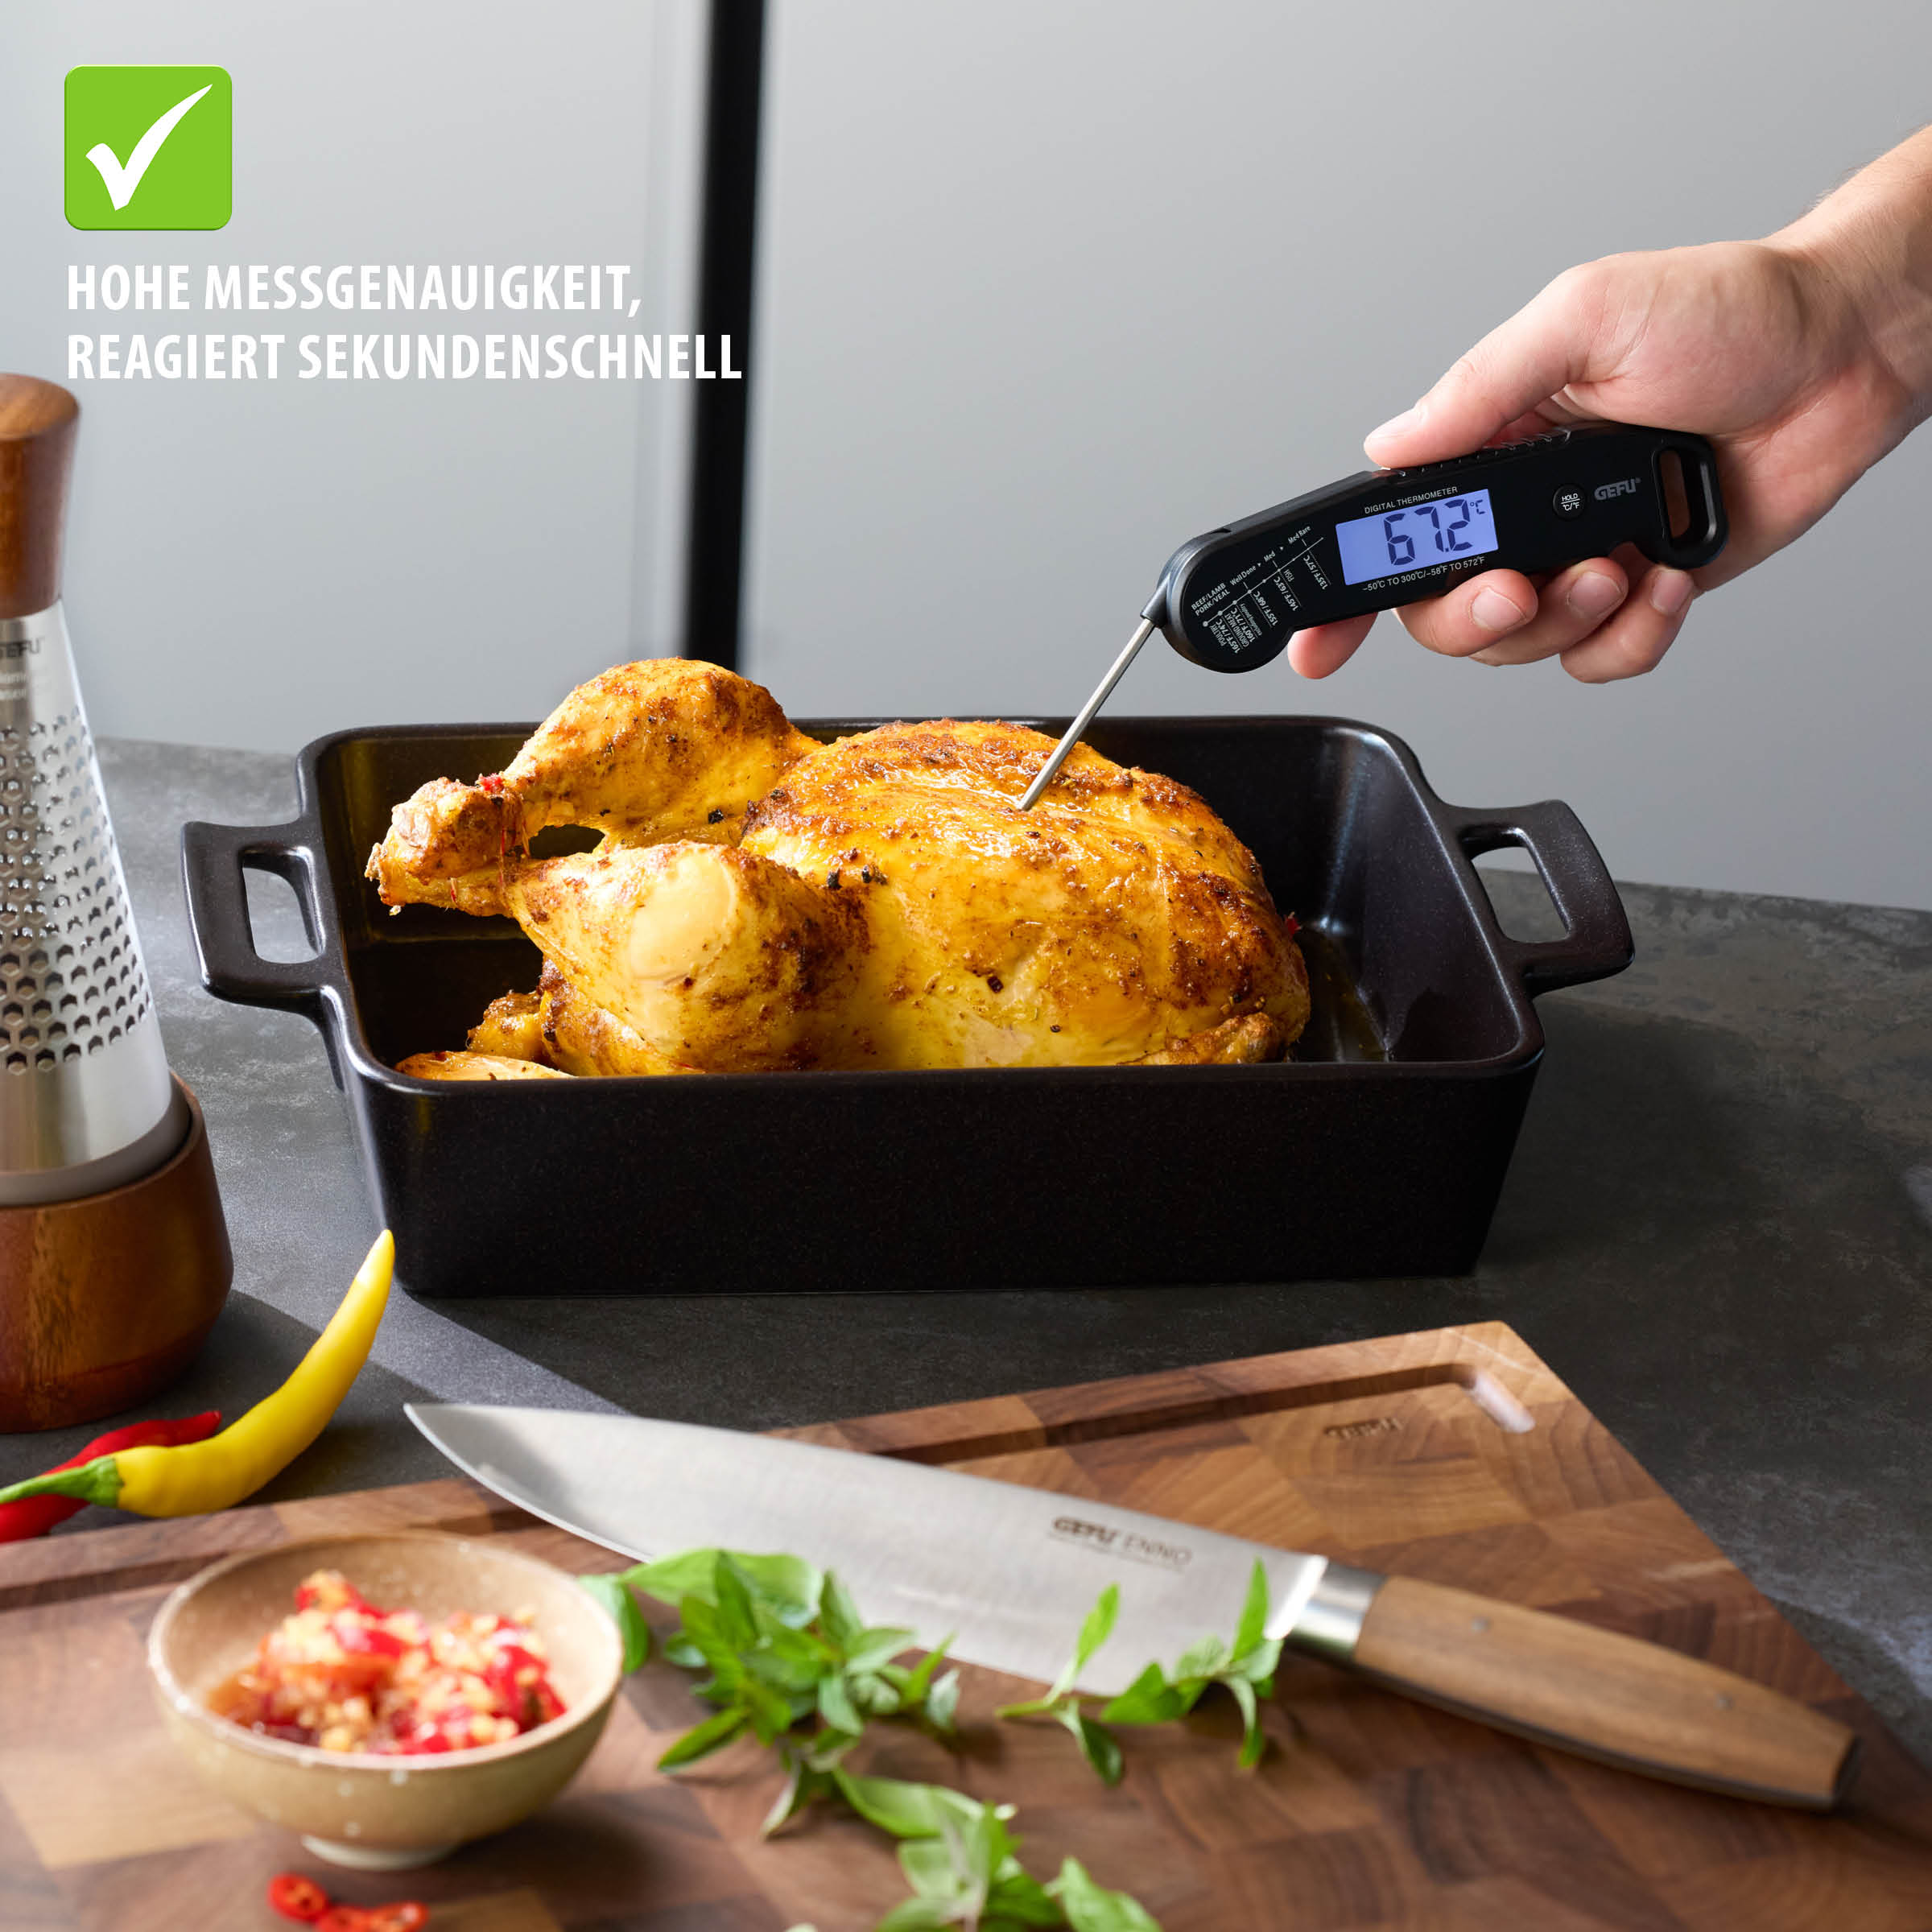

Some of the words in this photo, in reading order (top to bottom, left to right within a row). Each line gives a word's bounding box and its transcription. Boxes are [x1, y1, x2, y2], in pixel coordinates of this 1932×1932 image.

[1364, 502, 1396, 514] DIGITAL
[1397, 486, 1458, 506] THERMOMETER
[1561, 493, 1579, 502] HOLD
[1298, 526, 1311, 536] Rare
[1383, 499, 1472, 565] 67.2
[1264, 551, 1275, 562] Med
[1230, 574, 1243, 585] Well
[1241, 566, 1256, 578] Done
[1283, 569, 1294, 582] FISH
[1387, 577, 1399, 585] TO
[1449, 562, 1462, 571] TO
[1191, 583, 1226, 610] BEEF/LAMB
[1195, 589, 1230, 616] PORK/VEAL
[1224, 613, 1237, 628] MEAT
[1209, 624, 1227, 646] POULTRY
[1233, 625, 1249, 647] GROUND
